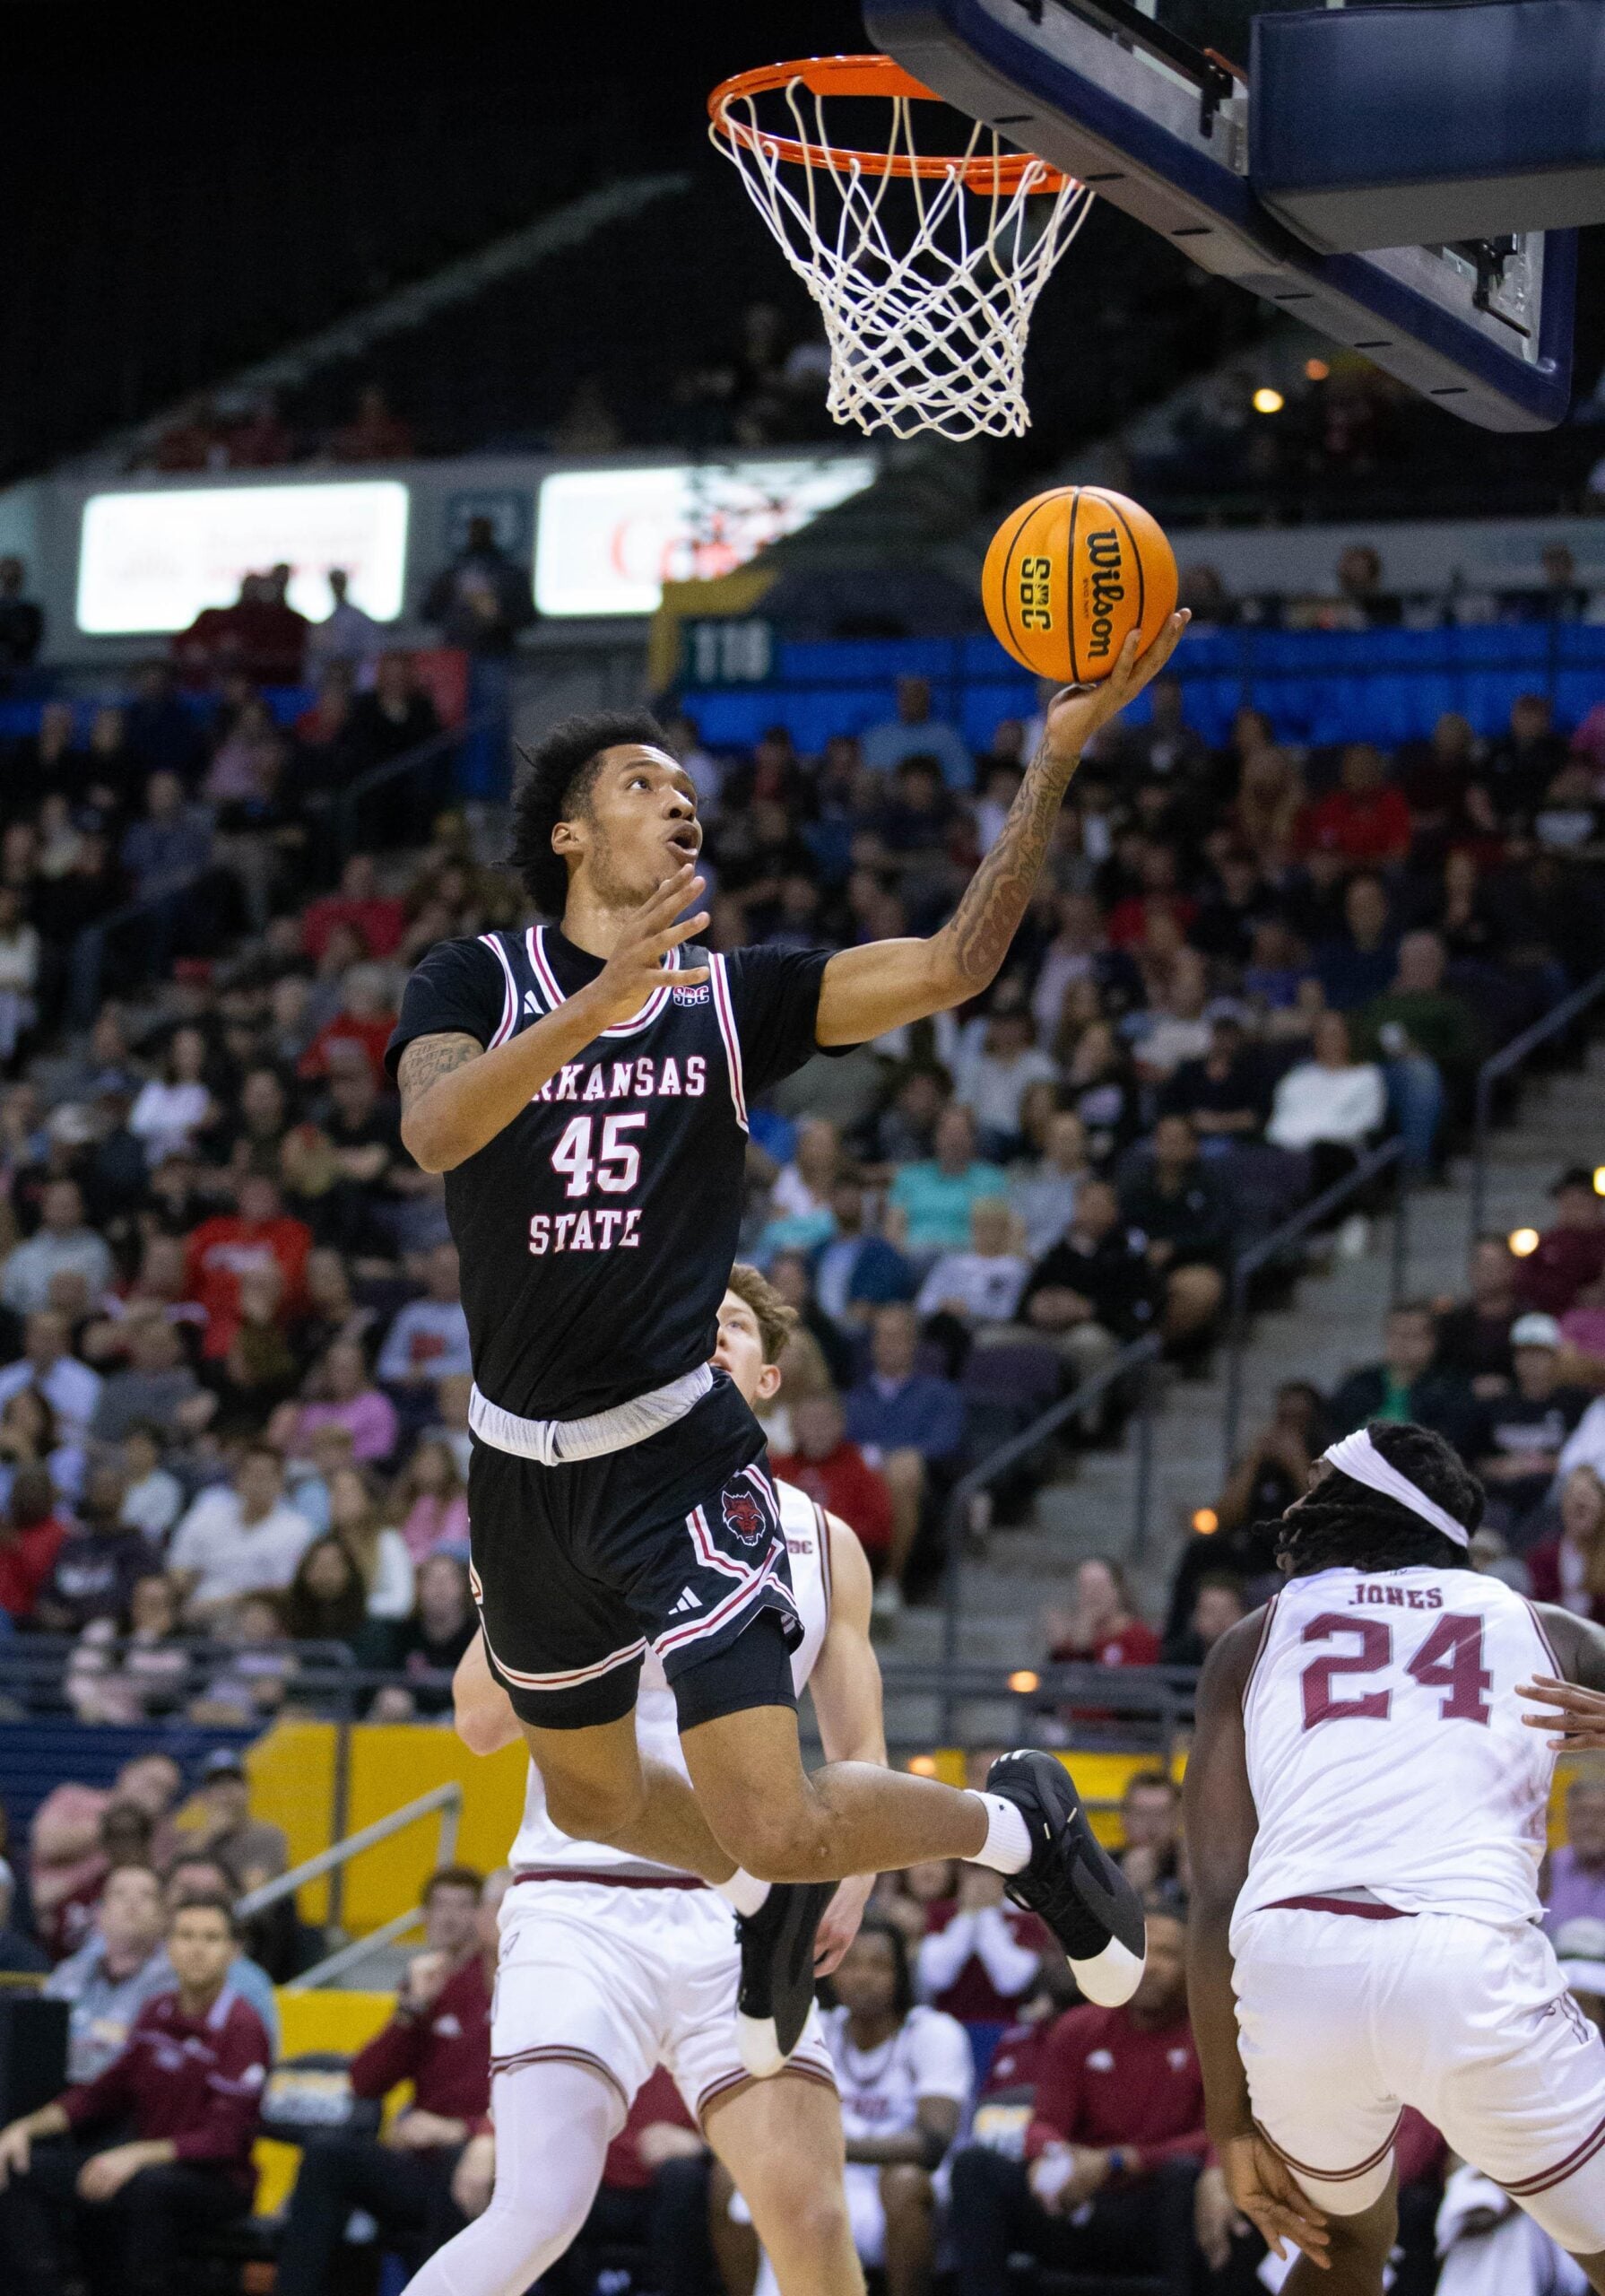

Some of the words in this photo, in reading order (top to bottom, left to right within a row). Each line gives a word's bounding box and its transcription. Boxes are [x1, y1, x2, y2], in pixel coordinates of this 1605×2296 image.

[1020, 557, 1052, 631] SBC
[1086, 527, 1124, 661] Wilson
[673, 986, 709, 1006] SBC
[529, 1057, 707, 1102] KANSAS
[551, 1111, 646, 1198] 45
[528, 1209, 643, 1255] STATE
[1348, 1583, 1444, 1609] JONES
[1300, 1613, 1494, 1733] 24
